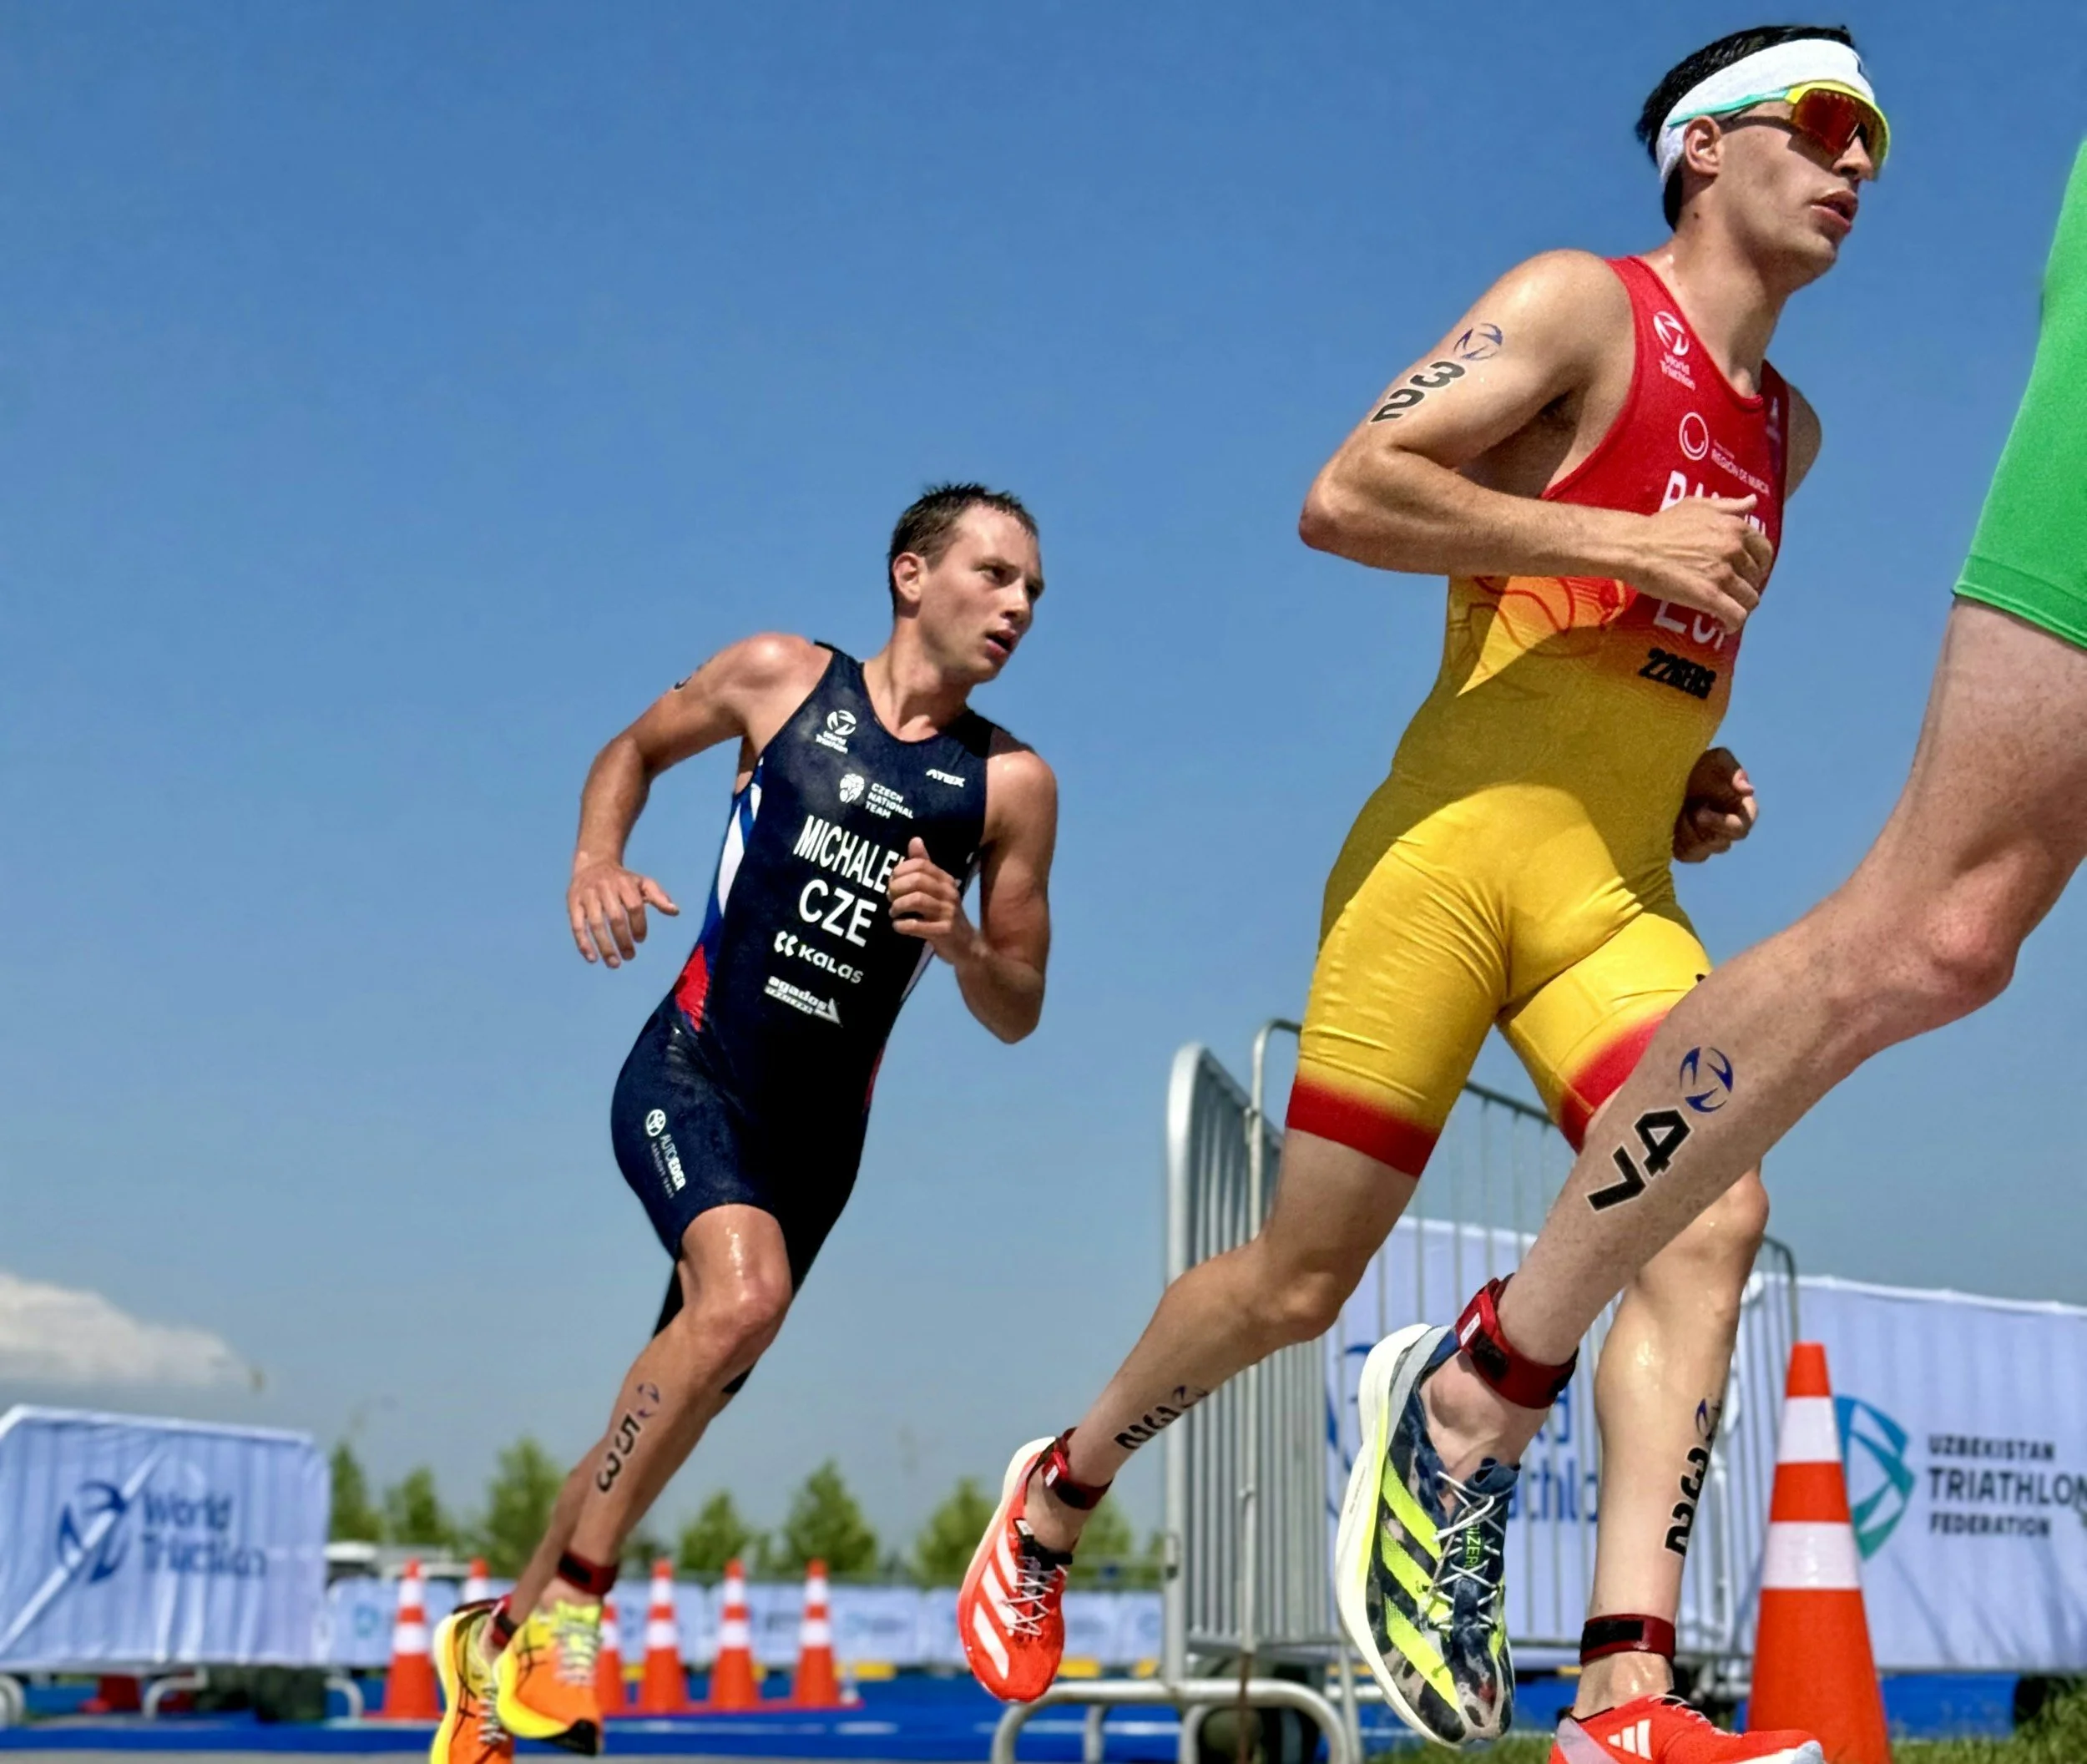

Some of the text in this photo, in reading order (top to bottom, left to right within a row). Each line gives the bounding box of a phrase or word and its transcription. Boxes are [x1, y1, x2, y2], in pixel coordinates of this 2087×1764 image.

[867, 791, 913, 819] NATIONAL
[871, 783, 903, 803] CZECH
[865, 801, 891, 819] TEAM
[793, 815, 906, 894] MICHALE
[799, 879, 877, 948] CZE
[1928, 1434, 2054, 1461] UZBEKISTAN
[1929, 1512, 2051, 1538] FEDERATION
